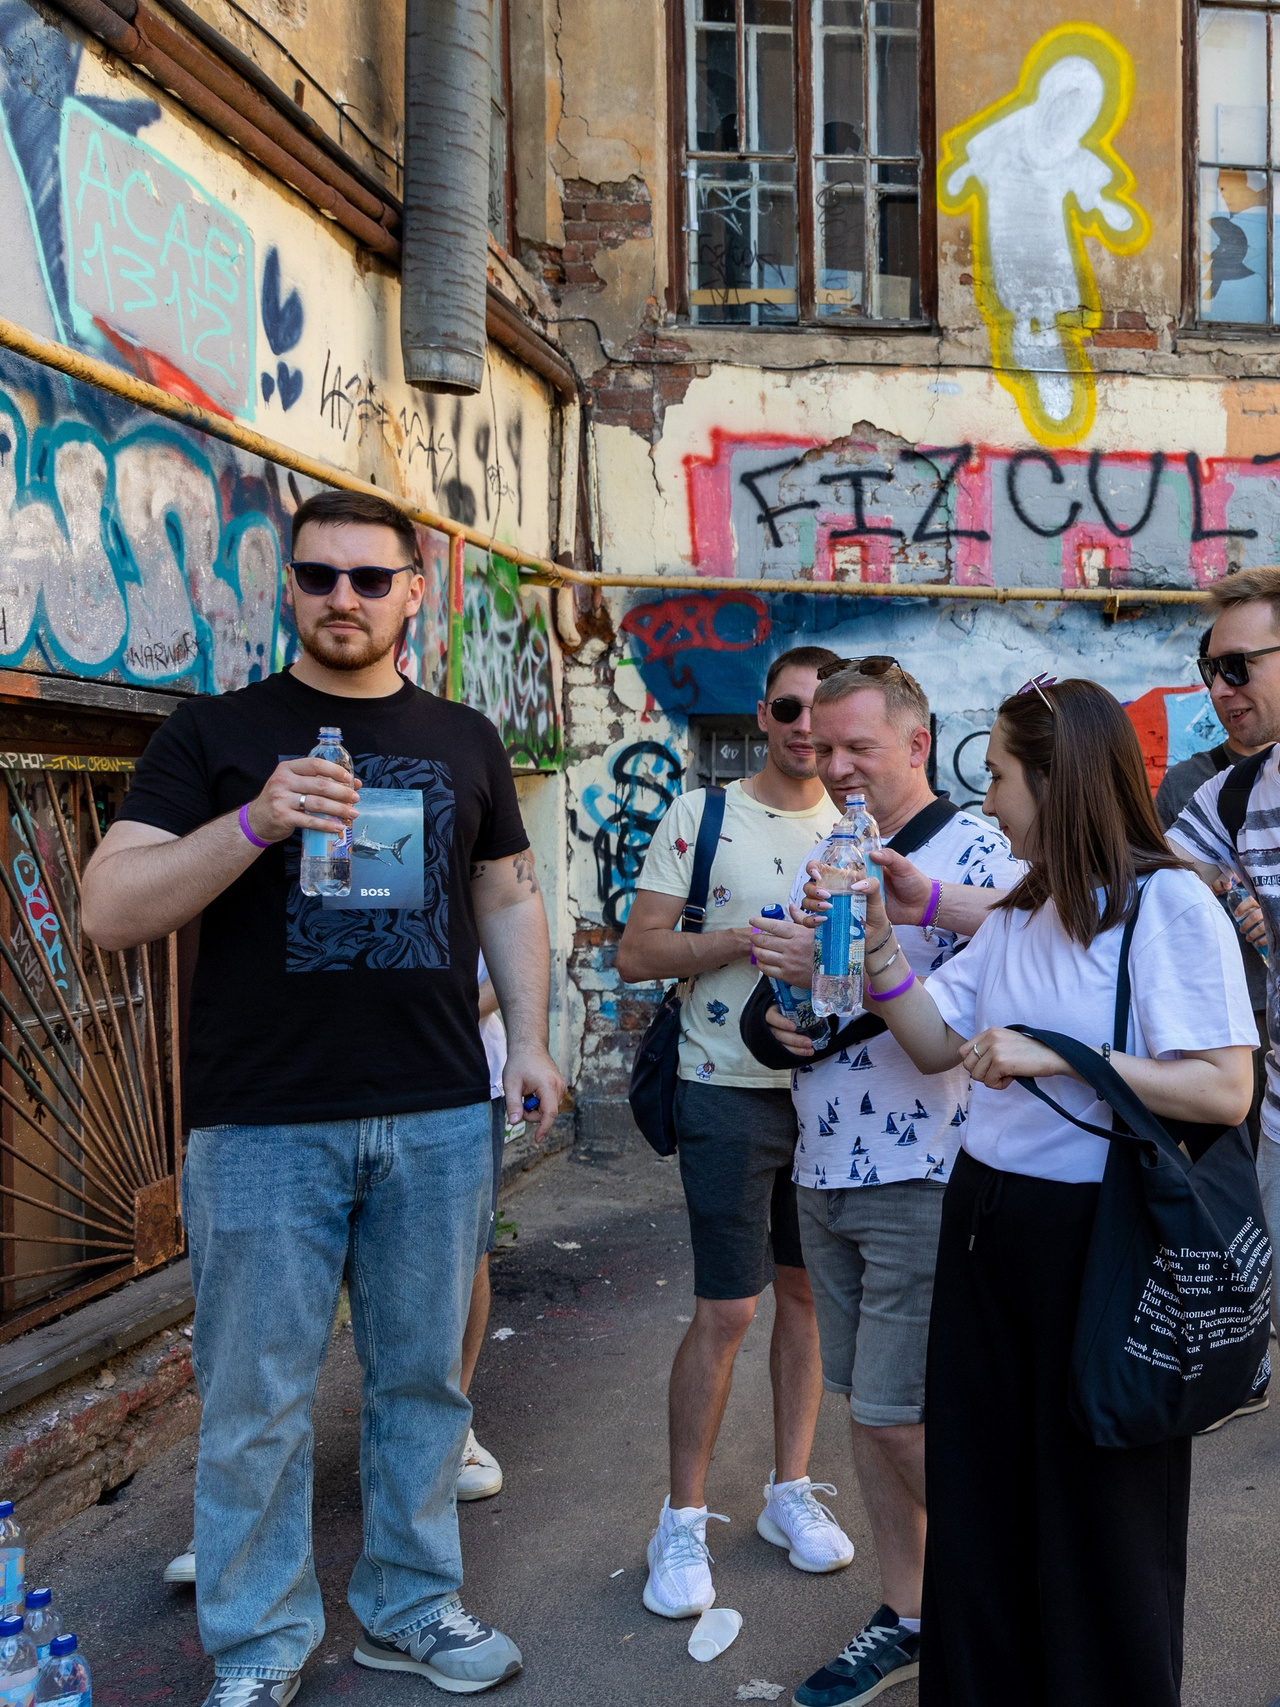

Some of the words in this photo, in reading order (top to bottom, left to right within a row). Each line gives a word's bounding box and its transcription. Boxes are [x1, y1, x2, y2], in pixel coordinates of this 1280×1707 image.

[76, 130, 240, 305] ACAB
[81, 221, 237, 390] 1312
[360, 888, 391, 897] BOSS
[1181, 1247, 1222, 1260] Постум,
[1198, 1263, 1210, 1271] но
[1142, 1289, 1161, 1306] Или
[1138, 1301, 1177, 1328] Постелю
[1219, 1306, 1245, 1314] вина,
[1133, 1314, 1140, 1323] и
[1186, 1345, 1201, 1354] как
[1126, 1336, 1148, 1352] Иосиф
